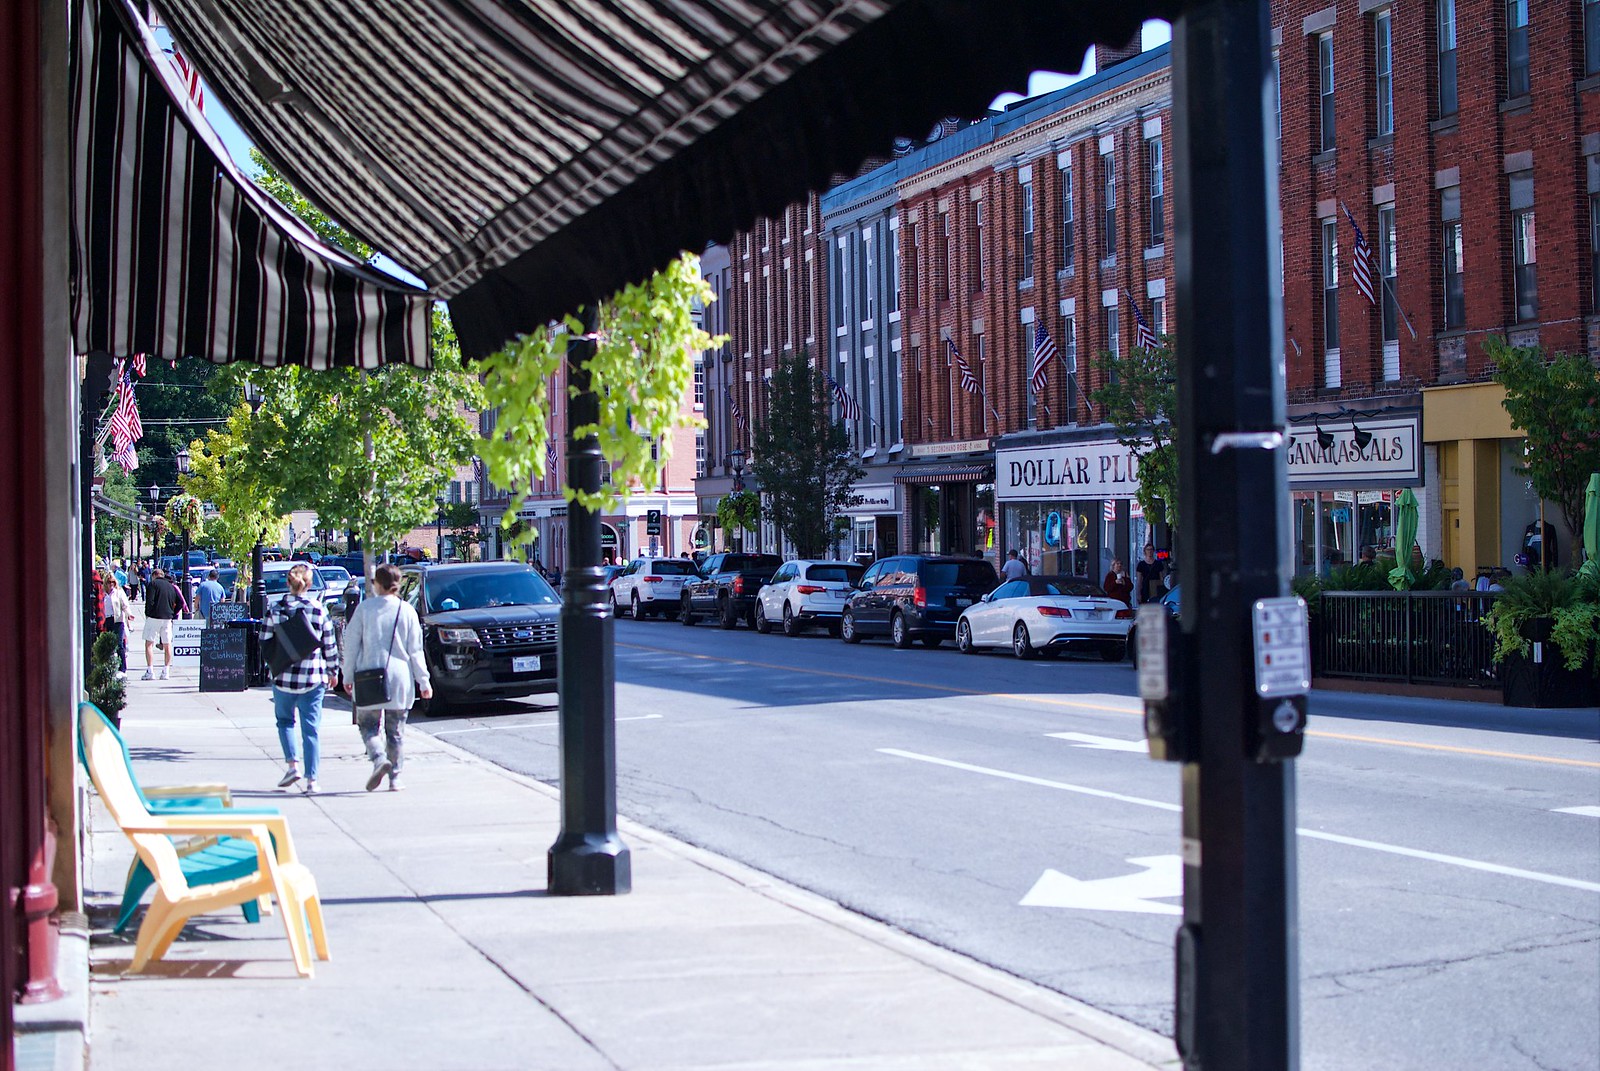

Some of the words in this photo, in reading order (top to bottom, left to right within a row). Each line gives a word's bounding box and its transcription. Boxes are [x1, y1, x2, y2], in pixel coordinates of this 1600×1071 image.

[1009, 457, 1090, 487] DOLLAR
[1098, 454, 1138, 483] PLU
[210, 651, 244, 661] Clothing
